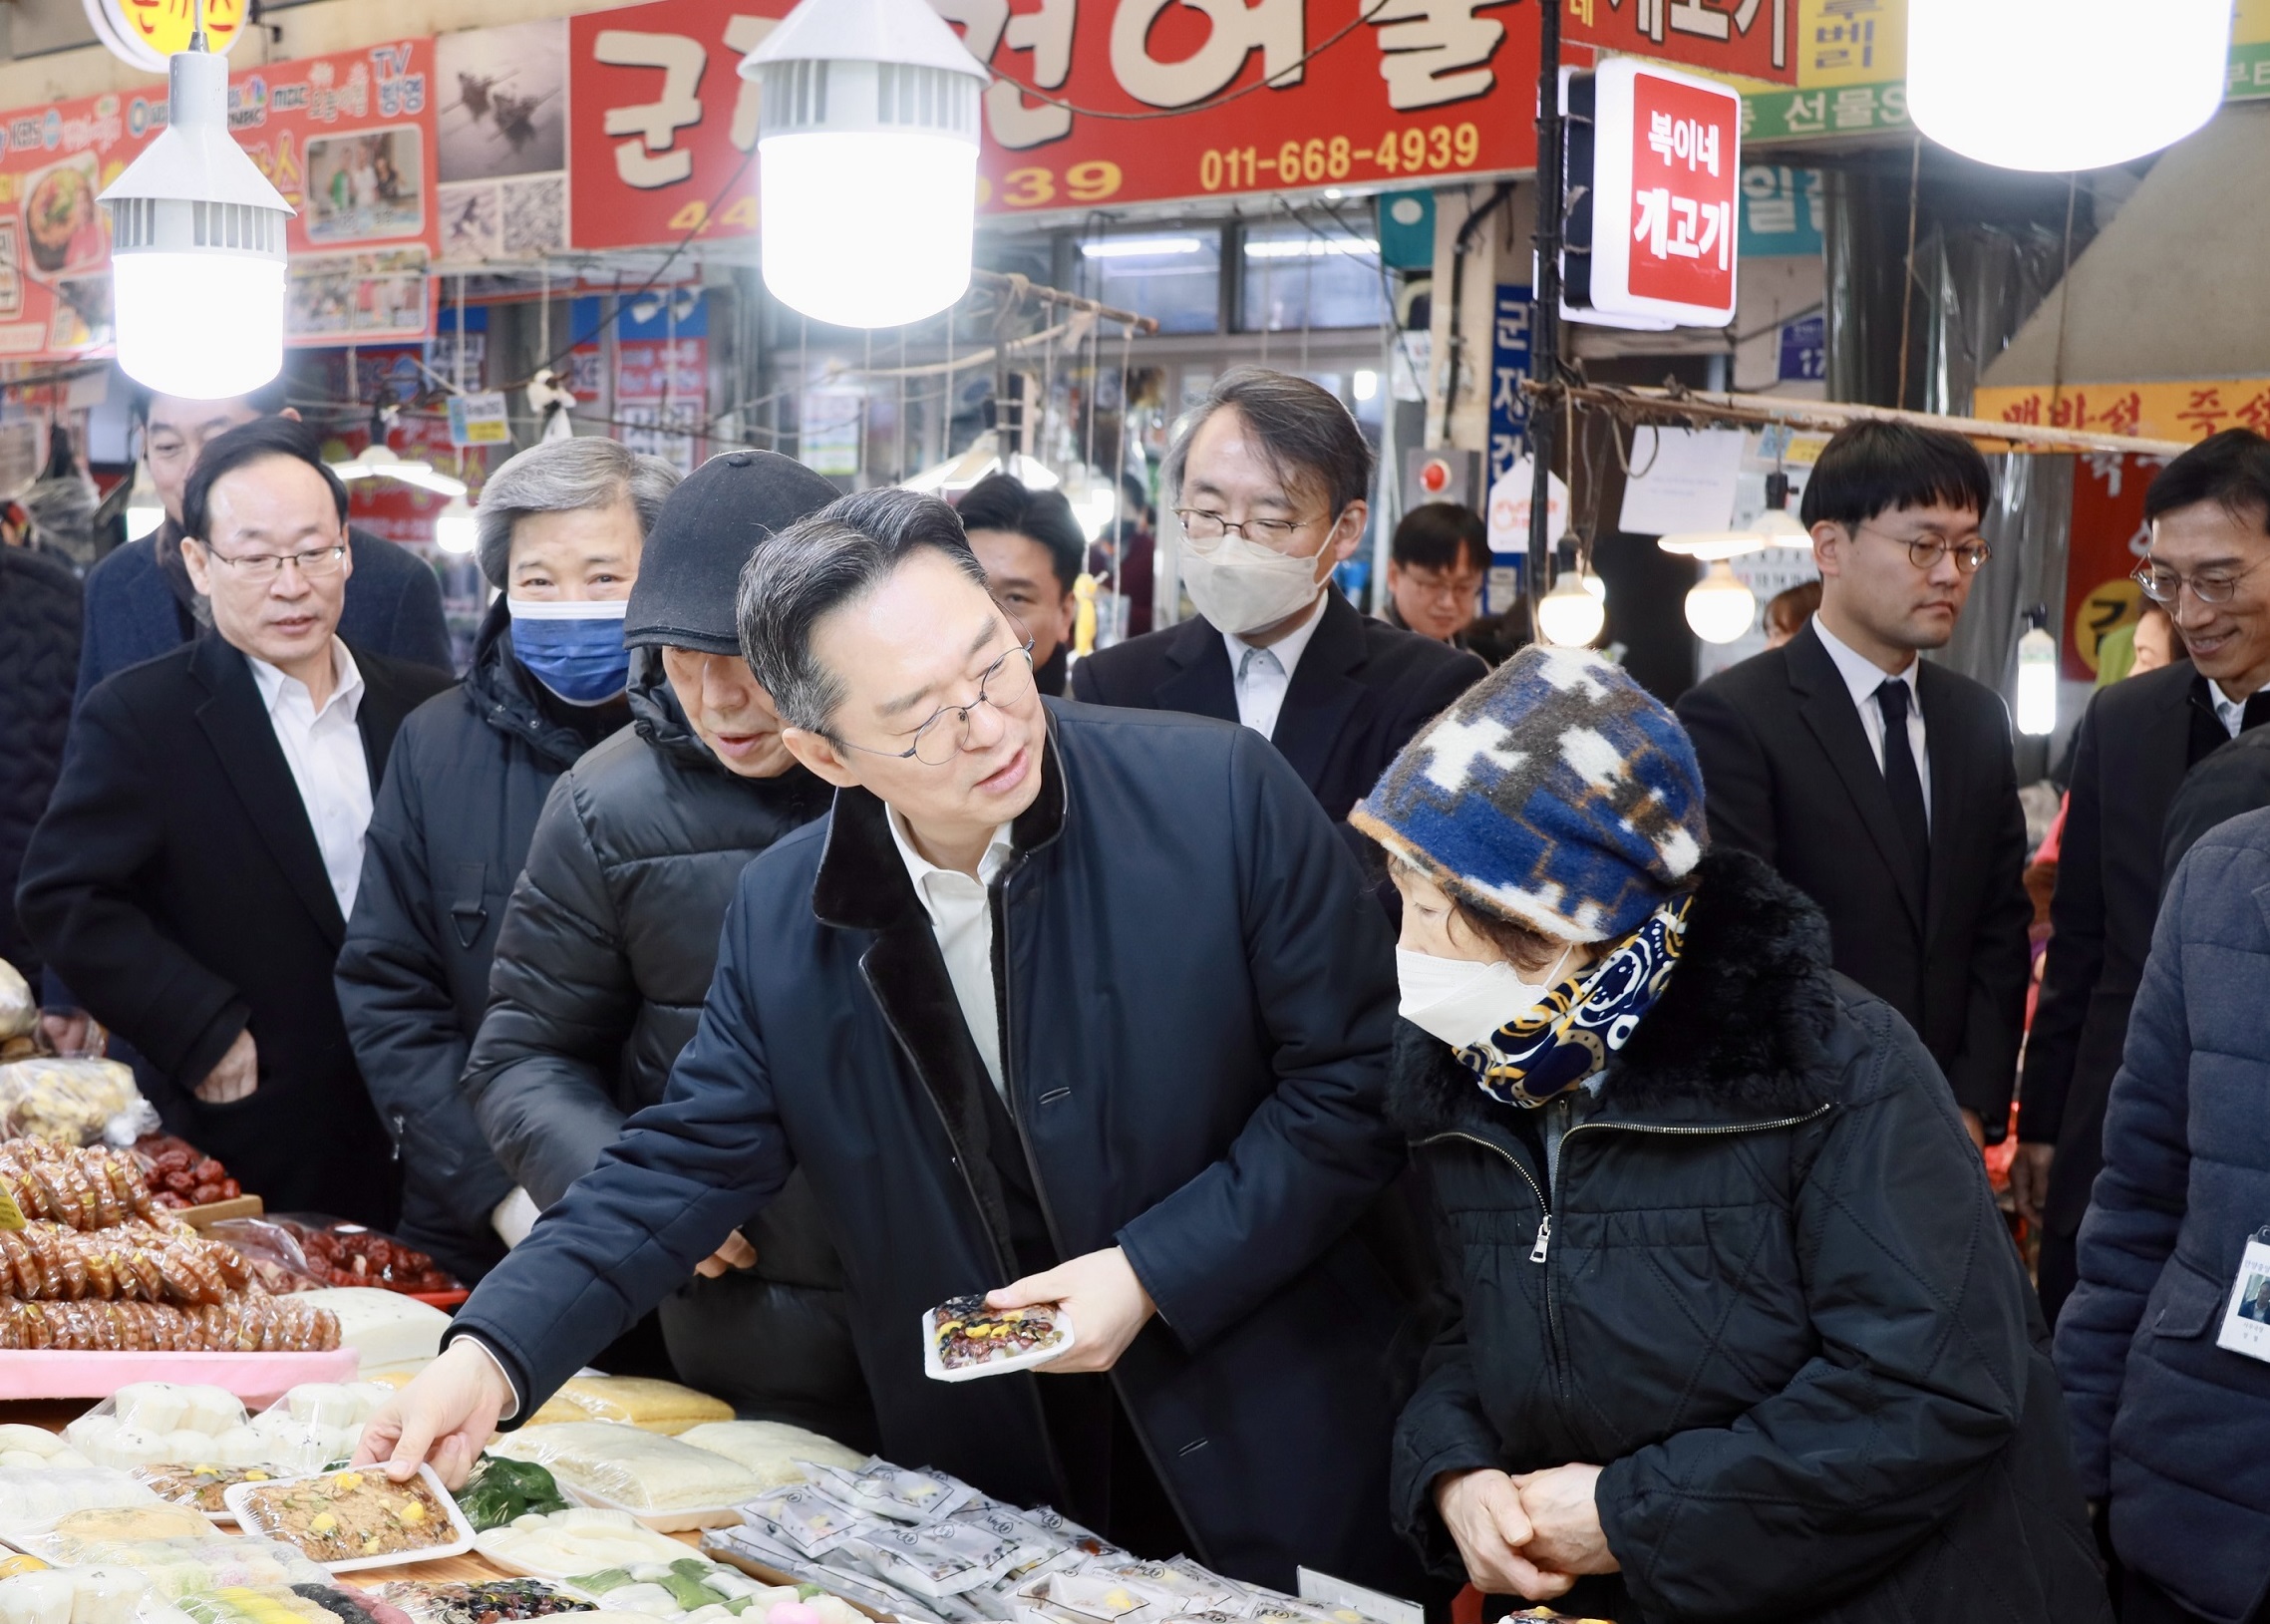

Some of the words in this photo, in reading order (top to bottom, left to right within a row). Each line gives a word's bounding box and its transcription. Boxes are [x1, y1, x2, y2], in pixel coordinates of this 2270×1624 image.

[594, 0, 1511, 188] 군건어물
[1199, 122, 1479, 191] 011-668-4939
[1648, 111, 1720, 177] 복이네
[1633, 187, 1731, 271] 개고기
